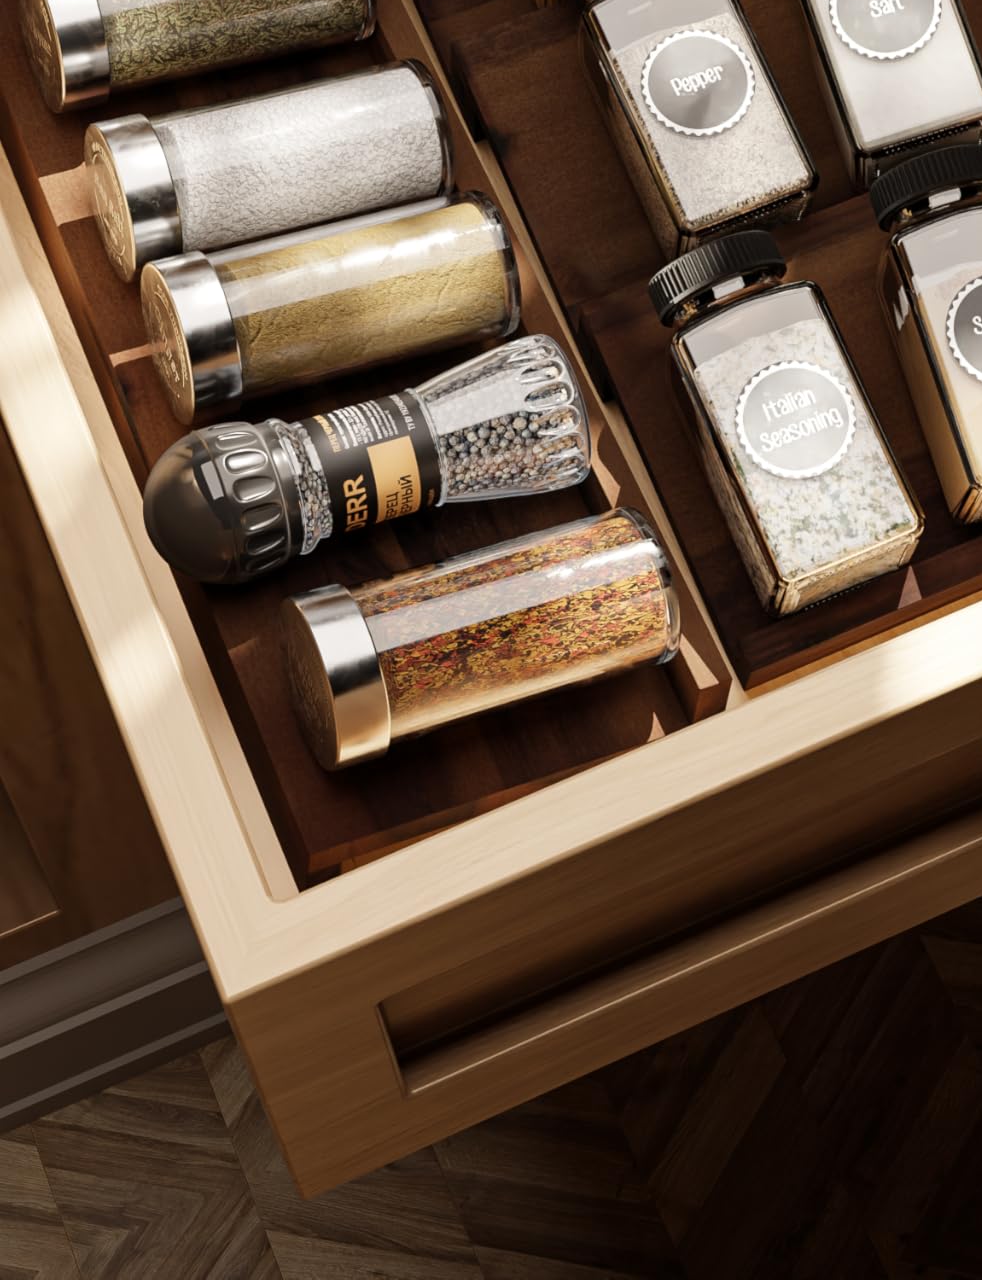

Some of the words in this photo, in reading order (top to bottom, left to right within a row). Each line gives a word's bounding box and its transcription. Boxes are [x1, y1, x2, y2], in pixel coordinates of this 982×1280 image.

[669, 65, 724, 97] Pepper
[761, 389, 817, 424] Italian
[759, 407, 844, 453] Seasoning
[398, 474, 412, 514] ЕРНЫЙ
